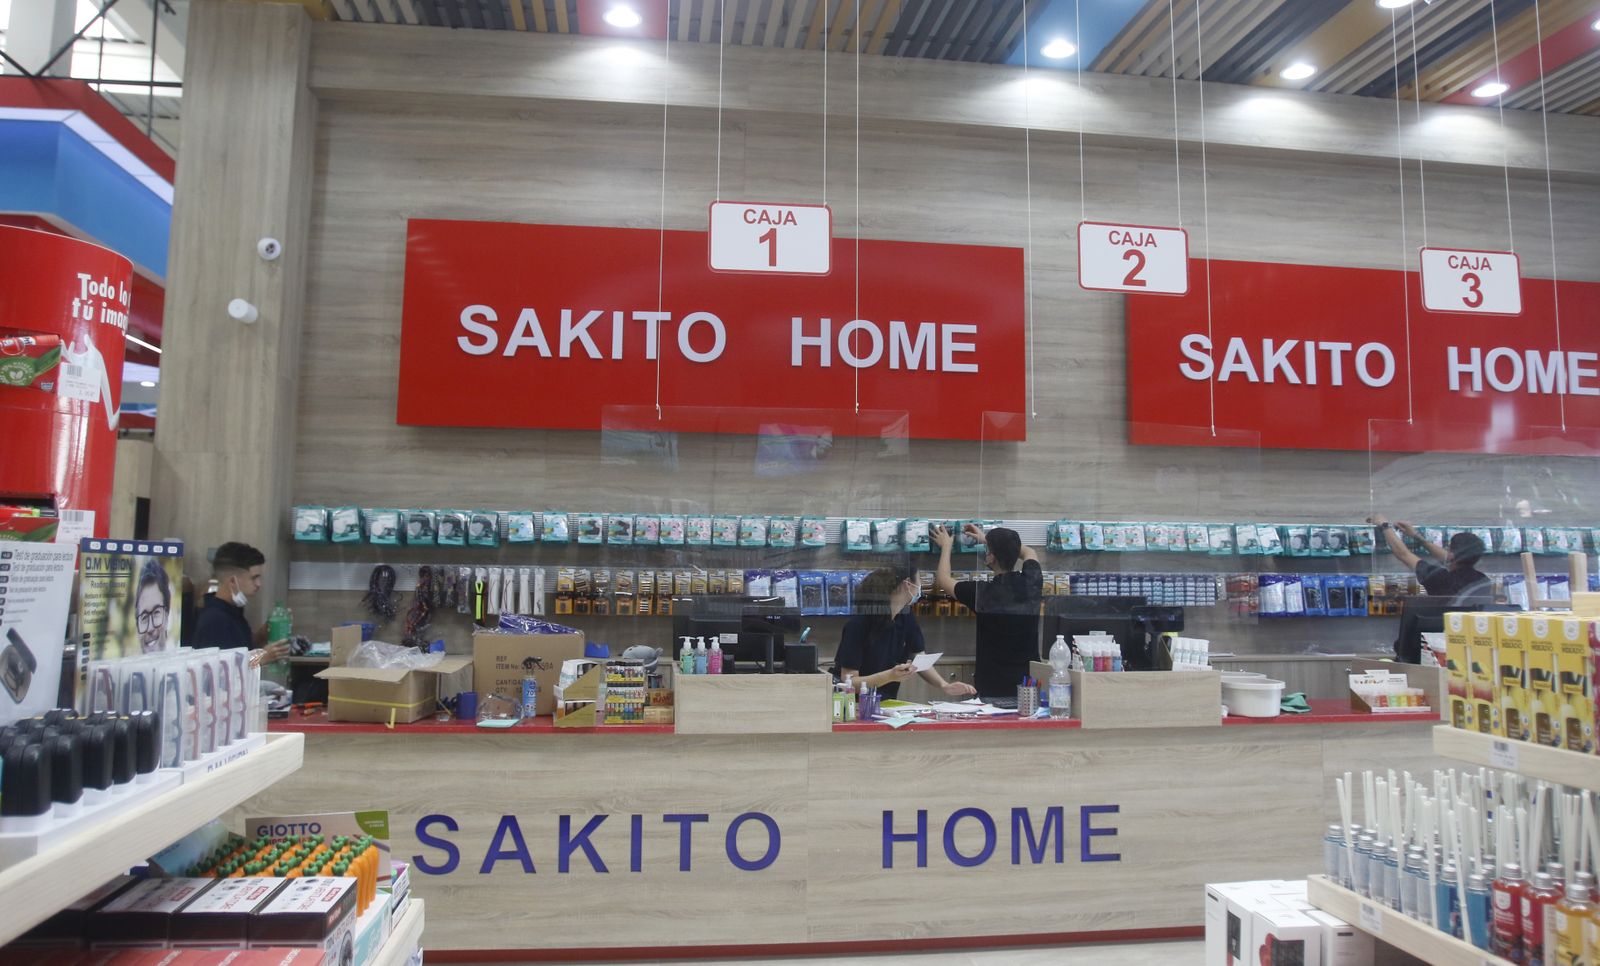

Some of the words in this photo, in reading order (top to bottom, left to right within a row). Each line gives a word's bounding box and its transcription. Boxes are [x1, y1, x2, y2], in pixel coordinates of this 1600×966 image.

[743, 208, 798, 226] CAJA
[758, 229, 778, 267] 1
[1108, 230, 1158, 248] CAJA
[1122, 250, 1147, 287] 2
[1447, 254, 1493, 272] CAJA
[77, 272, 116, 301] Todo
[119, 281, 128, 307] lo
[1461, 273, 1484, 309] 3
[72, 297, 94, 321] tú
[457, 304, 727, 363] SAKITO
[791, 316, 979, 373] HOME
[1179, 333, 1396, 388] SAKITO
[1447, 346, 1599, 396] HOME
[256, 822, 322, 839] GIOTTO
[411, 811, 782, 876] SAKITO
[881, 803, 1122, 869] HOME
